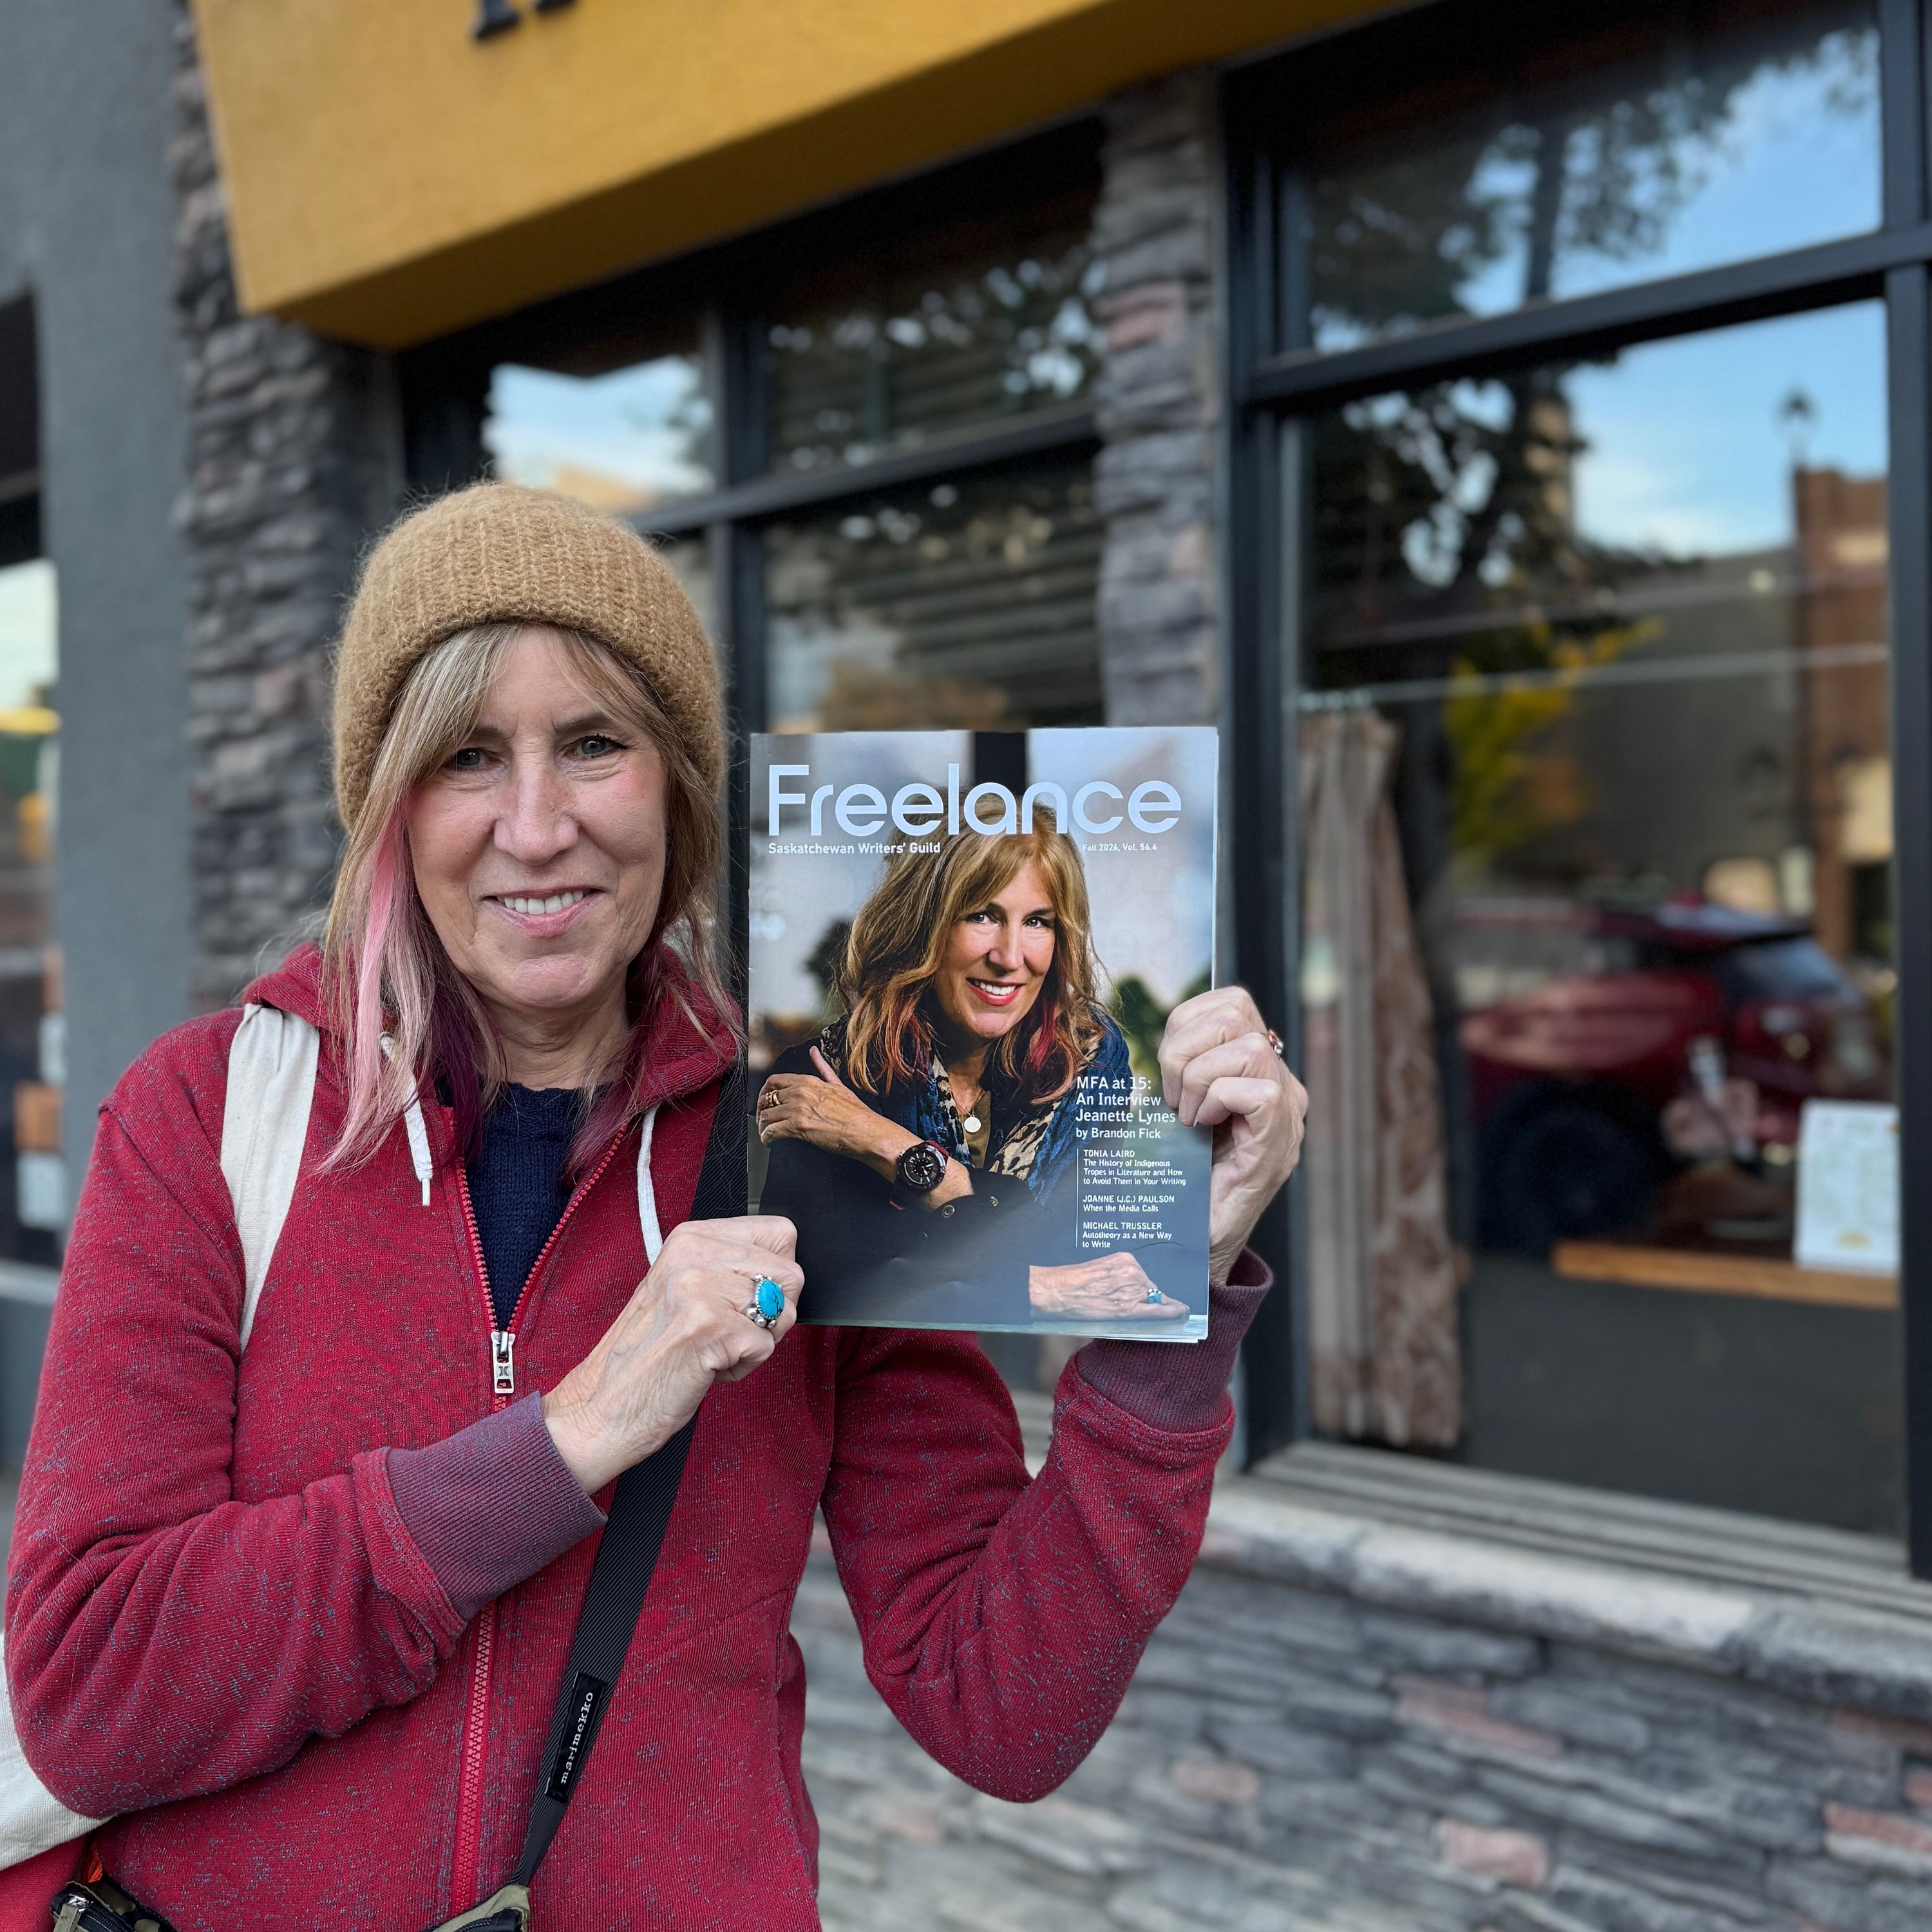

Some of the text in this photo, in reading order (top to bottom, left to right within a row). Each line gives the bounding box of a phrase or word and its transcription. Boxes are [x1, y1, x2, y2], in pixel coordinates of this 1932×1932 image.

[769, 763, 1182, 837] Freelance
[768, 842, 940, 854] Saskatchewan Writers' Guild
[1077, 1076, 1151, 1090] MFA at 15:
[1076, 1092, 1161, 1106] An Interview
[1075, 1109, 1175, 1124] Jeanette Lynes
[1075, 1128, 1161, 1139] by Brandon Fick
[1099, 1159, 1123, 1168] History
[1083, 1231, 1121, 1240] Autotheory
[561, 1692, 593, 1784] marimekko
